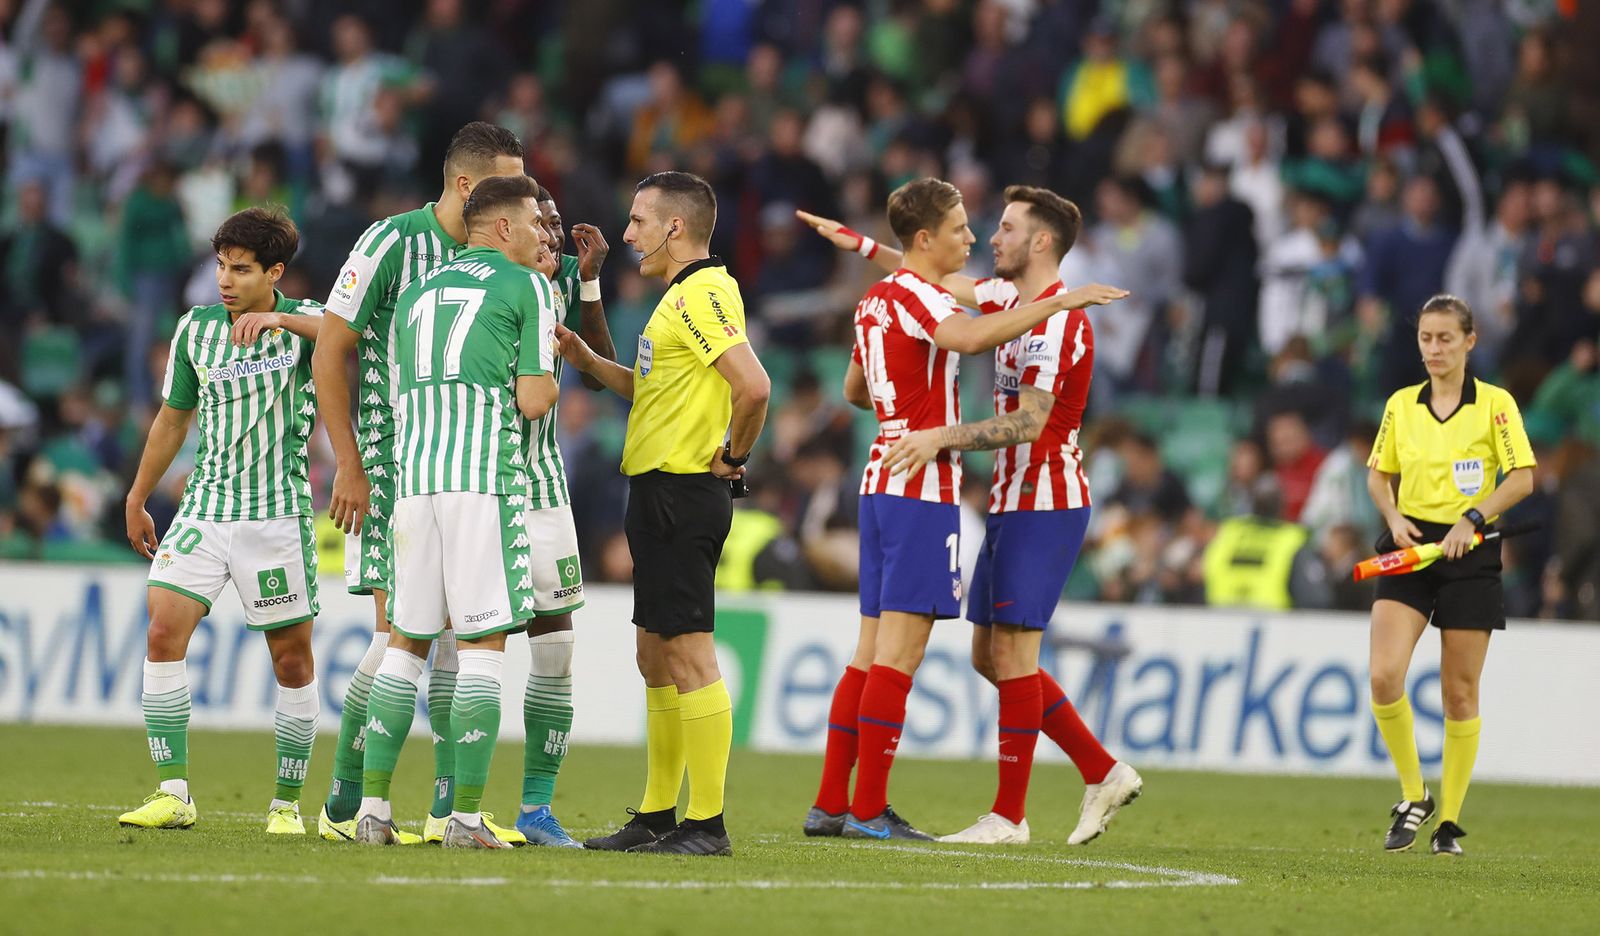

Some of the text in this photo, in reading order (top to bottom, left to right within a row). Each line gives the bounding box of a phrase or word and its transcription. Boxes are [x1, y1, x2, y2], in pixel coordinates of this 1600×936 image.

[407, 286, 487, 383] 17
[682, 310, 713, 354] WÜRTH
[208, 354, 294, 382] easyMarkets
[1455, 460, 1480, 471] FIFA
[160, 521, 203, 555] 20
[945, 532, 958, 573] 1
[254, 593, 298, 608] BESOCCER
[464, 609, 498, 623] Kappa
[148, 736, 169, 750] EAL
[150, 749, 173, 762] ETIS
